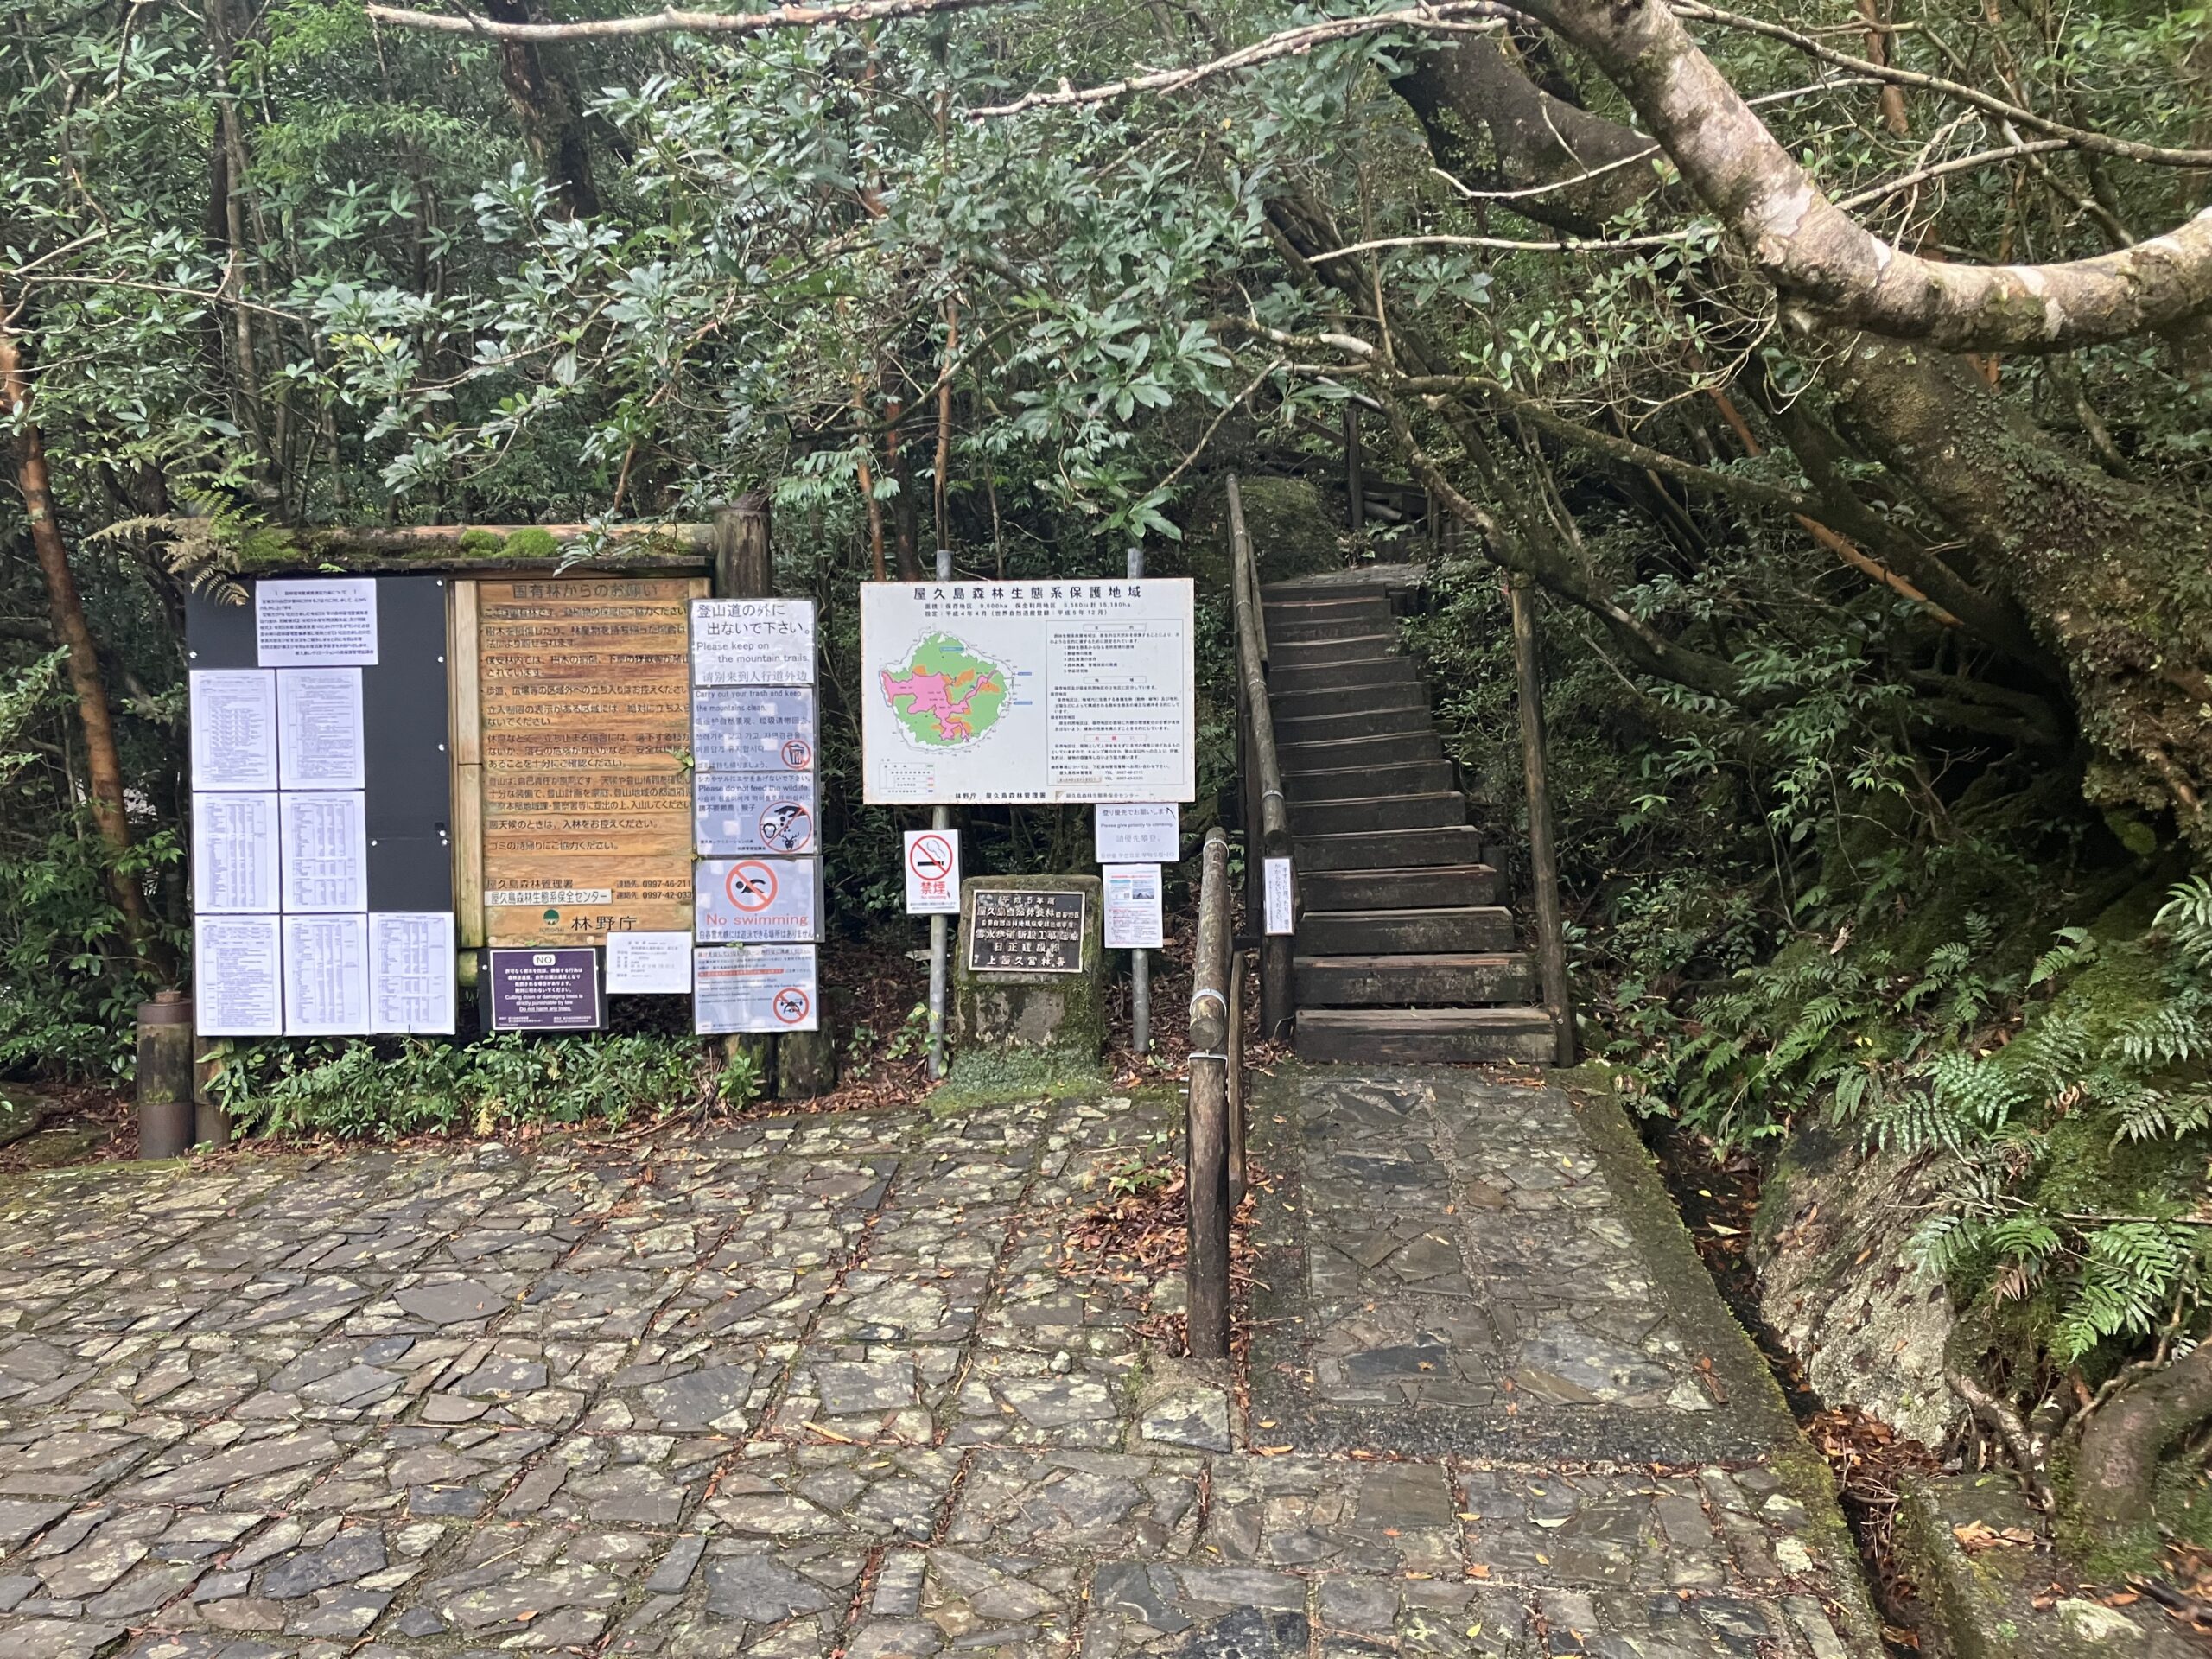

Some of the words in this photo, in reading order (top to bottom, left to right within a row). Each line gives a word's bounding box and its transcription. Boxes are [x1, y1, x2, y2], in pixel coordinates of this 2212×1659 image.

[914, 586, 1141, 601] 屋久島森林生態系保護地域
[697, 604, 785, 618] 登山道の外に
[707, 621, 810, 635] 出ないで下さい。
[696, 642, 728, 651] Please
[732, 642, 753, 651] keep
[920, 881, 947, 894] 禁煙
[491, 890, 607, 905] 屋久島森林生態系保全センター
[571, 916, 637, 931] 林野庁
[706, 914, 727, 925] No
[734, 913, 808, 926] swimming
